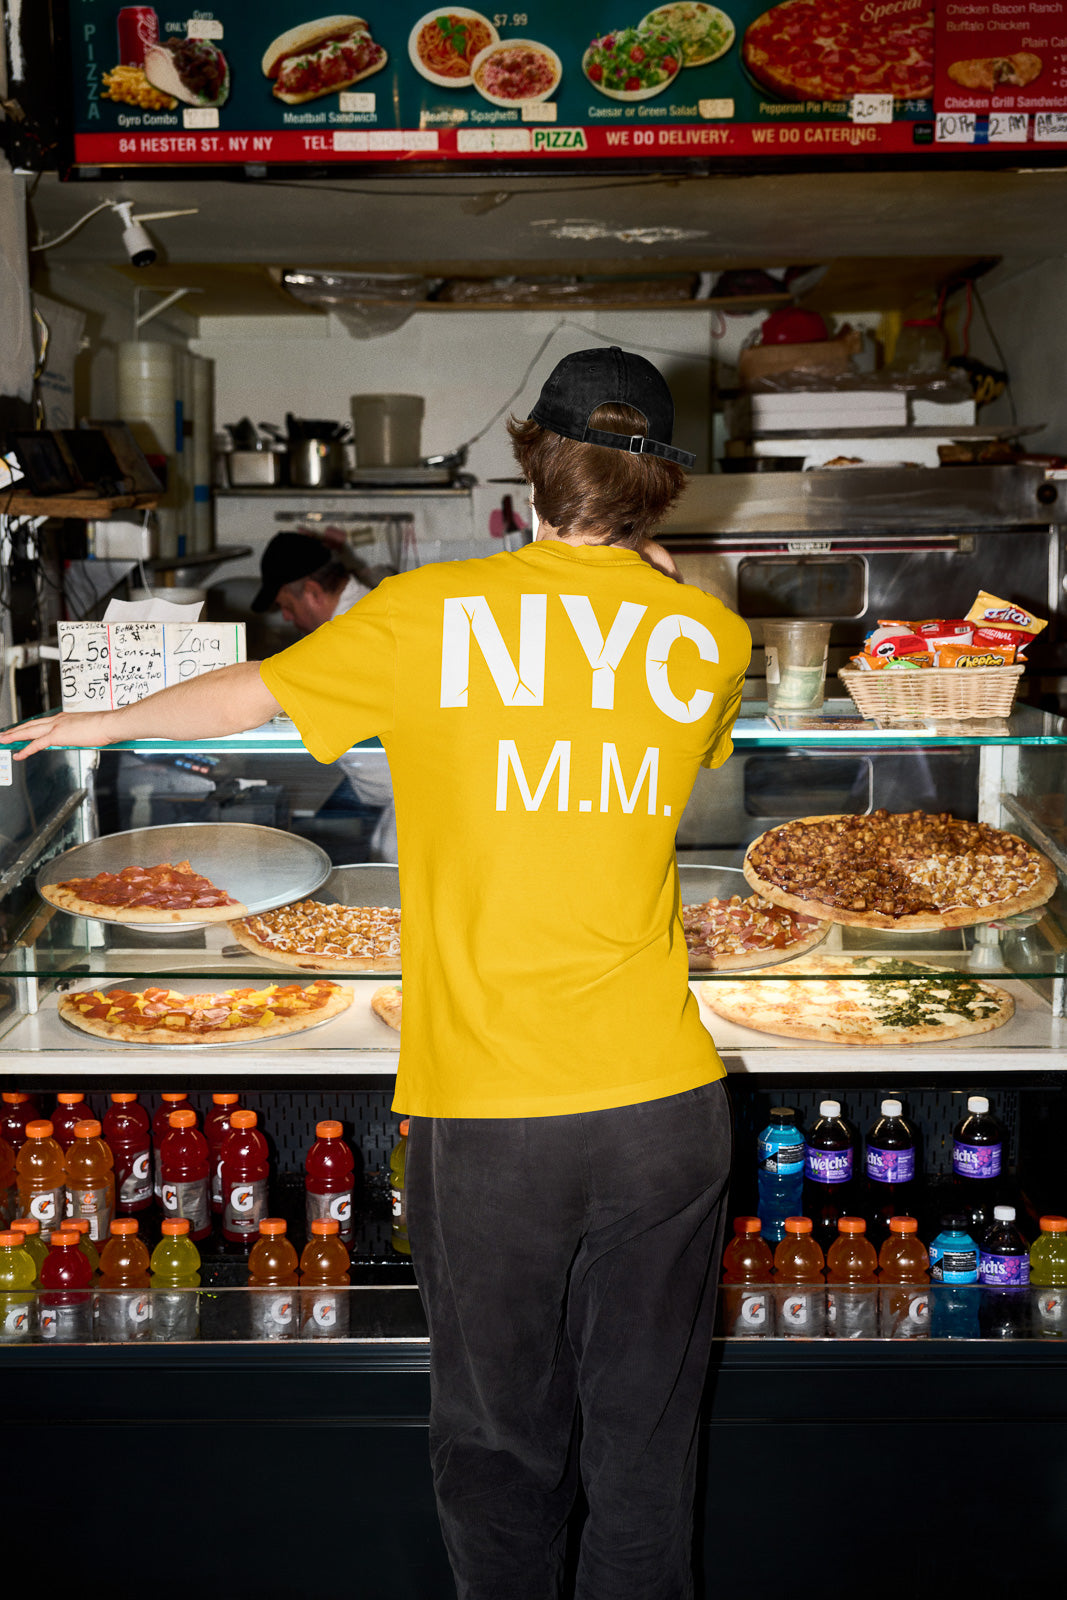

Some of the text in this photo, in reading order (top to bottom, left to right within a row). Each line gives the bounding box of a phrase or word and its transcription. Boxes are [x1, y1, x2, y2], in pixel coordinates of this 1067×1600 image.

[946, 2, 1062, 15] Chicken Bacon Ranch
[493, 14, 528, 27] $7.99
[946, 20, 1030, 32] Buffalo Chicken
[1021, 36, 1067, 48] Plain Cal
[84, 23, 101, 120] PIZZA
[759, 101, 846, 116] Pepperoni Pie Pizza
[945, 96, 989, 109] Chicken
[991, 96, 1016, 108] Grill
[283, 112, 377, 124] Meatball Sandwich
[471, 109, 518, 124] Spaghetti
[588, 106, 622, 118] Caesar
[624, 108, 635, 117] or
[638, 105, 667, 117] Green
[669, 104, 697, 116] Salad
[117, 114, 141, 128] Gyro
[143, 113, 178, 126] Combo
[938, 116, 957, 140] 10
[302, 135, 333, 150] TEL:
[535, 131, 584, 148] PIZZA
[606, 129, 735, 146] WE DO DELIVERY.
[752, 128, 776, 143] WE
[779, 128, 800, 143] DO
[119, 136, 273, 152] 84 HESTER ST. NY NY
[61, 633, 109, 662] 2 50
[173, 628, 220, 655] Zara
[440, 594, 719, 724] NYC
[496, 739, 672, 817] M.M.
[810, 1156, 848, 1171] Welch's
[30, 1193, 56, 1220] G
[231, 1186, 253, 1212] G
[330, 1194, 351, 1221] G
[313, 1299, 337, 1327] G
[742, 1296, 766, 1325] G
[783, 1296, 807, 1325] G
